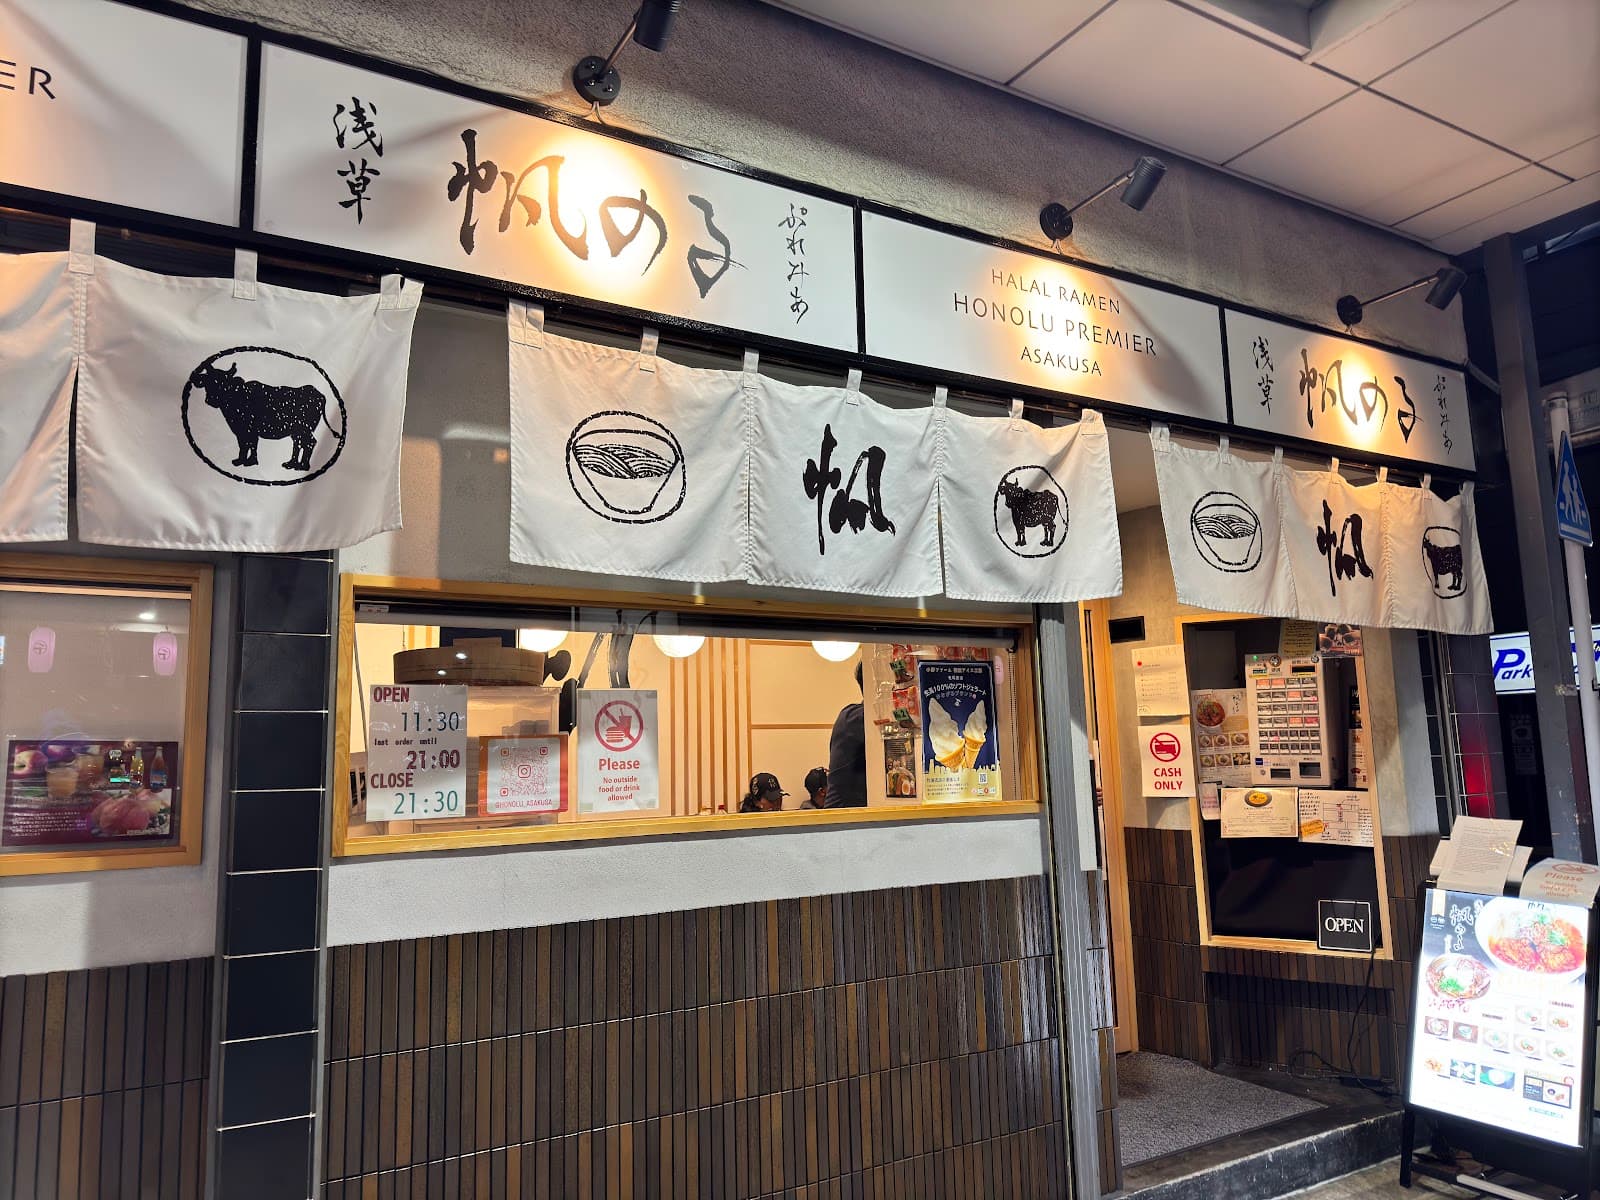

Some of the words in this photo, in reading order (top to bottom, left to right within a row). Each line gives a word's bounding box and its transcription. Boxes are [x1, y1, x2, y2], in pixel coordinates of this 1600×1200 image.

[334, 97, 384, 224] 浅草
[992, 269, 1051, 298] HALAL
[1059, 286, 1121, 314] RAMEN
[954, 292, 1054, 332] HONOLU
[1065, 319, 1156, 356] PREMIER
[1020, 346, 1102, 377] ASAKUSA
[1252, 336, 1274, 415] 浅草
[373, 687, 410, 702] OPEN
[402, 712, 459, 731] 11:30
[419, 737, 437, 745] until
[406, 749, 460, 770] 21:00
[598, 757, 640, 771] Please
[370, 772, 414, 789] CLOSE
[613, 775, 638, 784] outside
[1153, 767, 1182, 777] CASH
[623, 784, 640, 792] drink
[1154, 780, 1183, 791] ONLY
[394, 790, 458, 815] 21:30
[607, 793, 633, 802] allowed
[1324, 917, 1365, 934] OPEN
